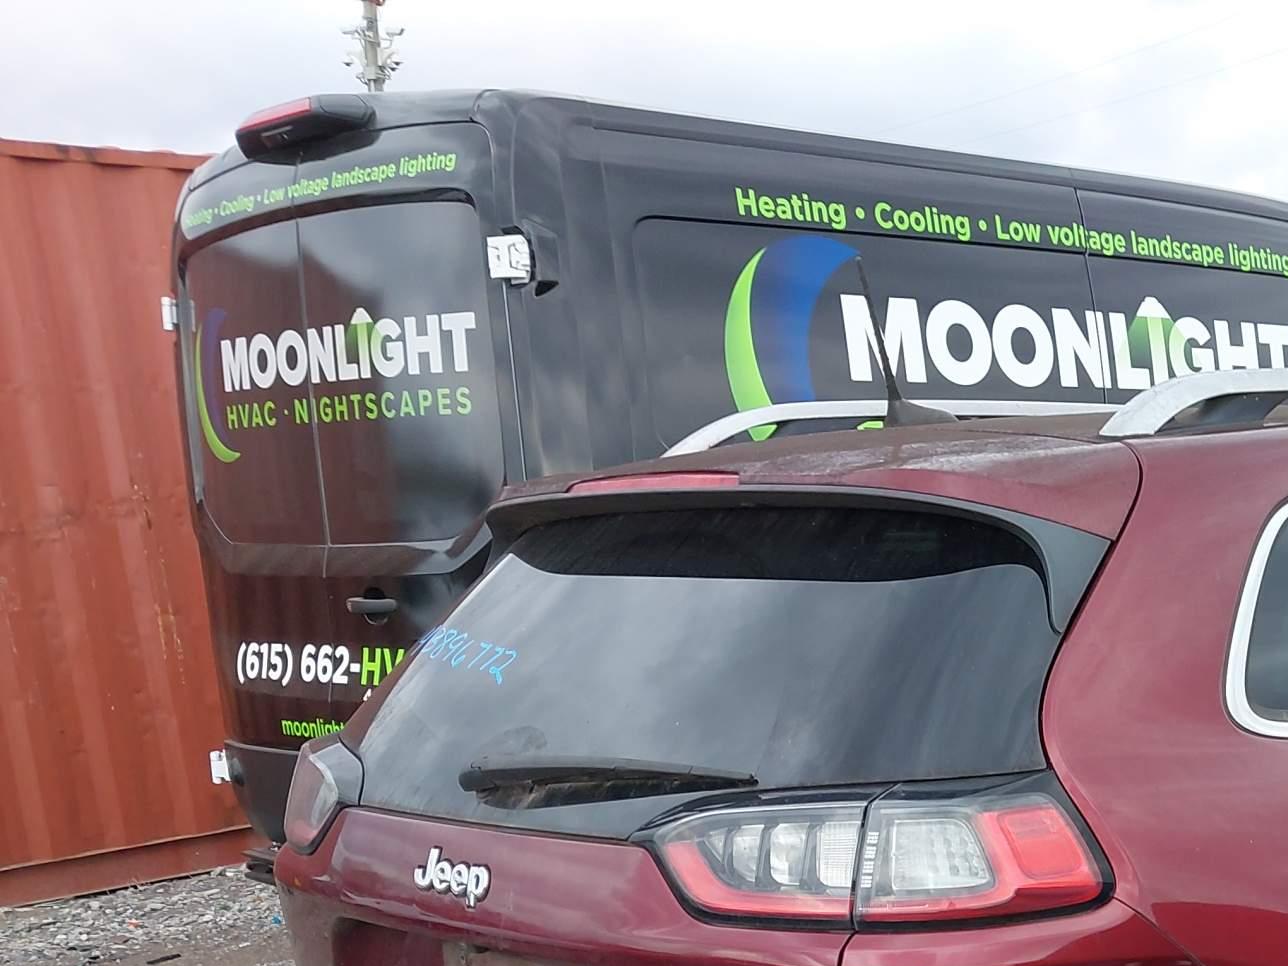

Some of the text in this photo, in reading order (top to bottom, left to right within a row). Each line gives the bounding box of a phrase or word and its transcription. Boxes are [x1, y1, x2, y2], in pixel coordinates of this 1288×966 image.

[220, 195, 255, 217] Cooling
[263, 187, 285, 205] Low
[287, 176, 329, 199] voltage
[331, 162, 395, 189] landscape
[399, 152, 457, 178] lighting
[735, 187, 848, 231] Heating
[874, 202, 972, 242] Cooling
[995, 214, 1041, 243] Low
[1047, 222, 1126, 256] voltage
[1130, 230, 1225, 267] landscape
[220, 307, 477, 393] MOONLIGHT
[226, 387, 472, 430] HVAC NIGHTSCAPES
[236, 642, 293, 687] (615)
[413, 845, 492, 909] Jeep
